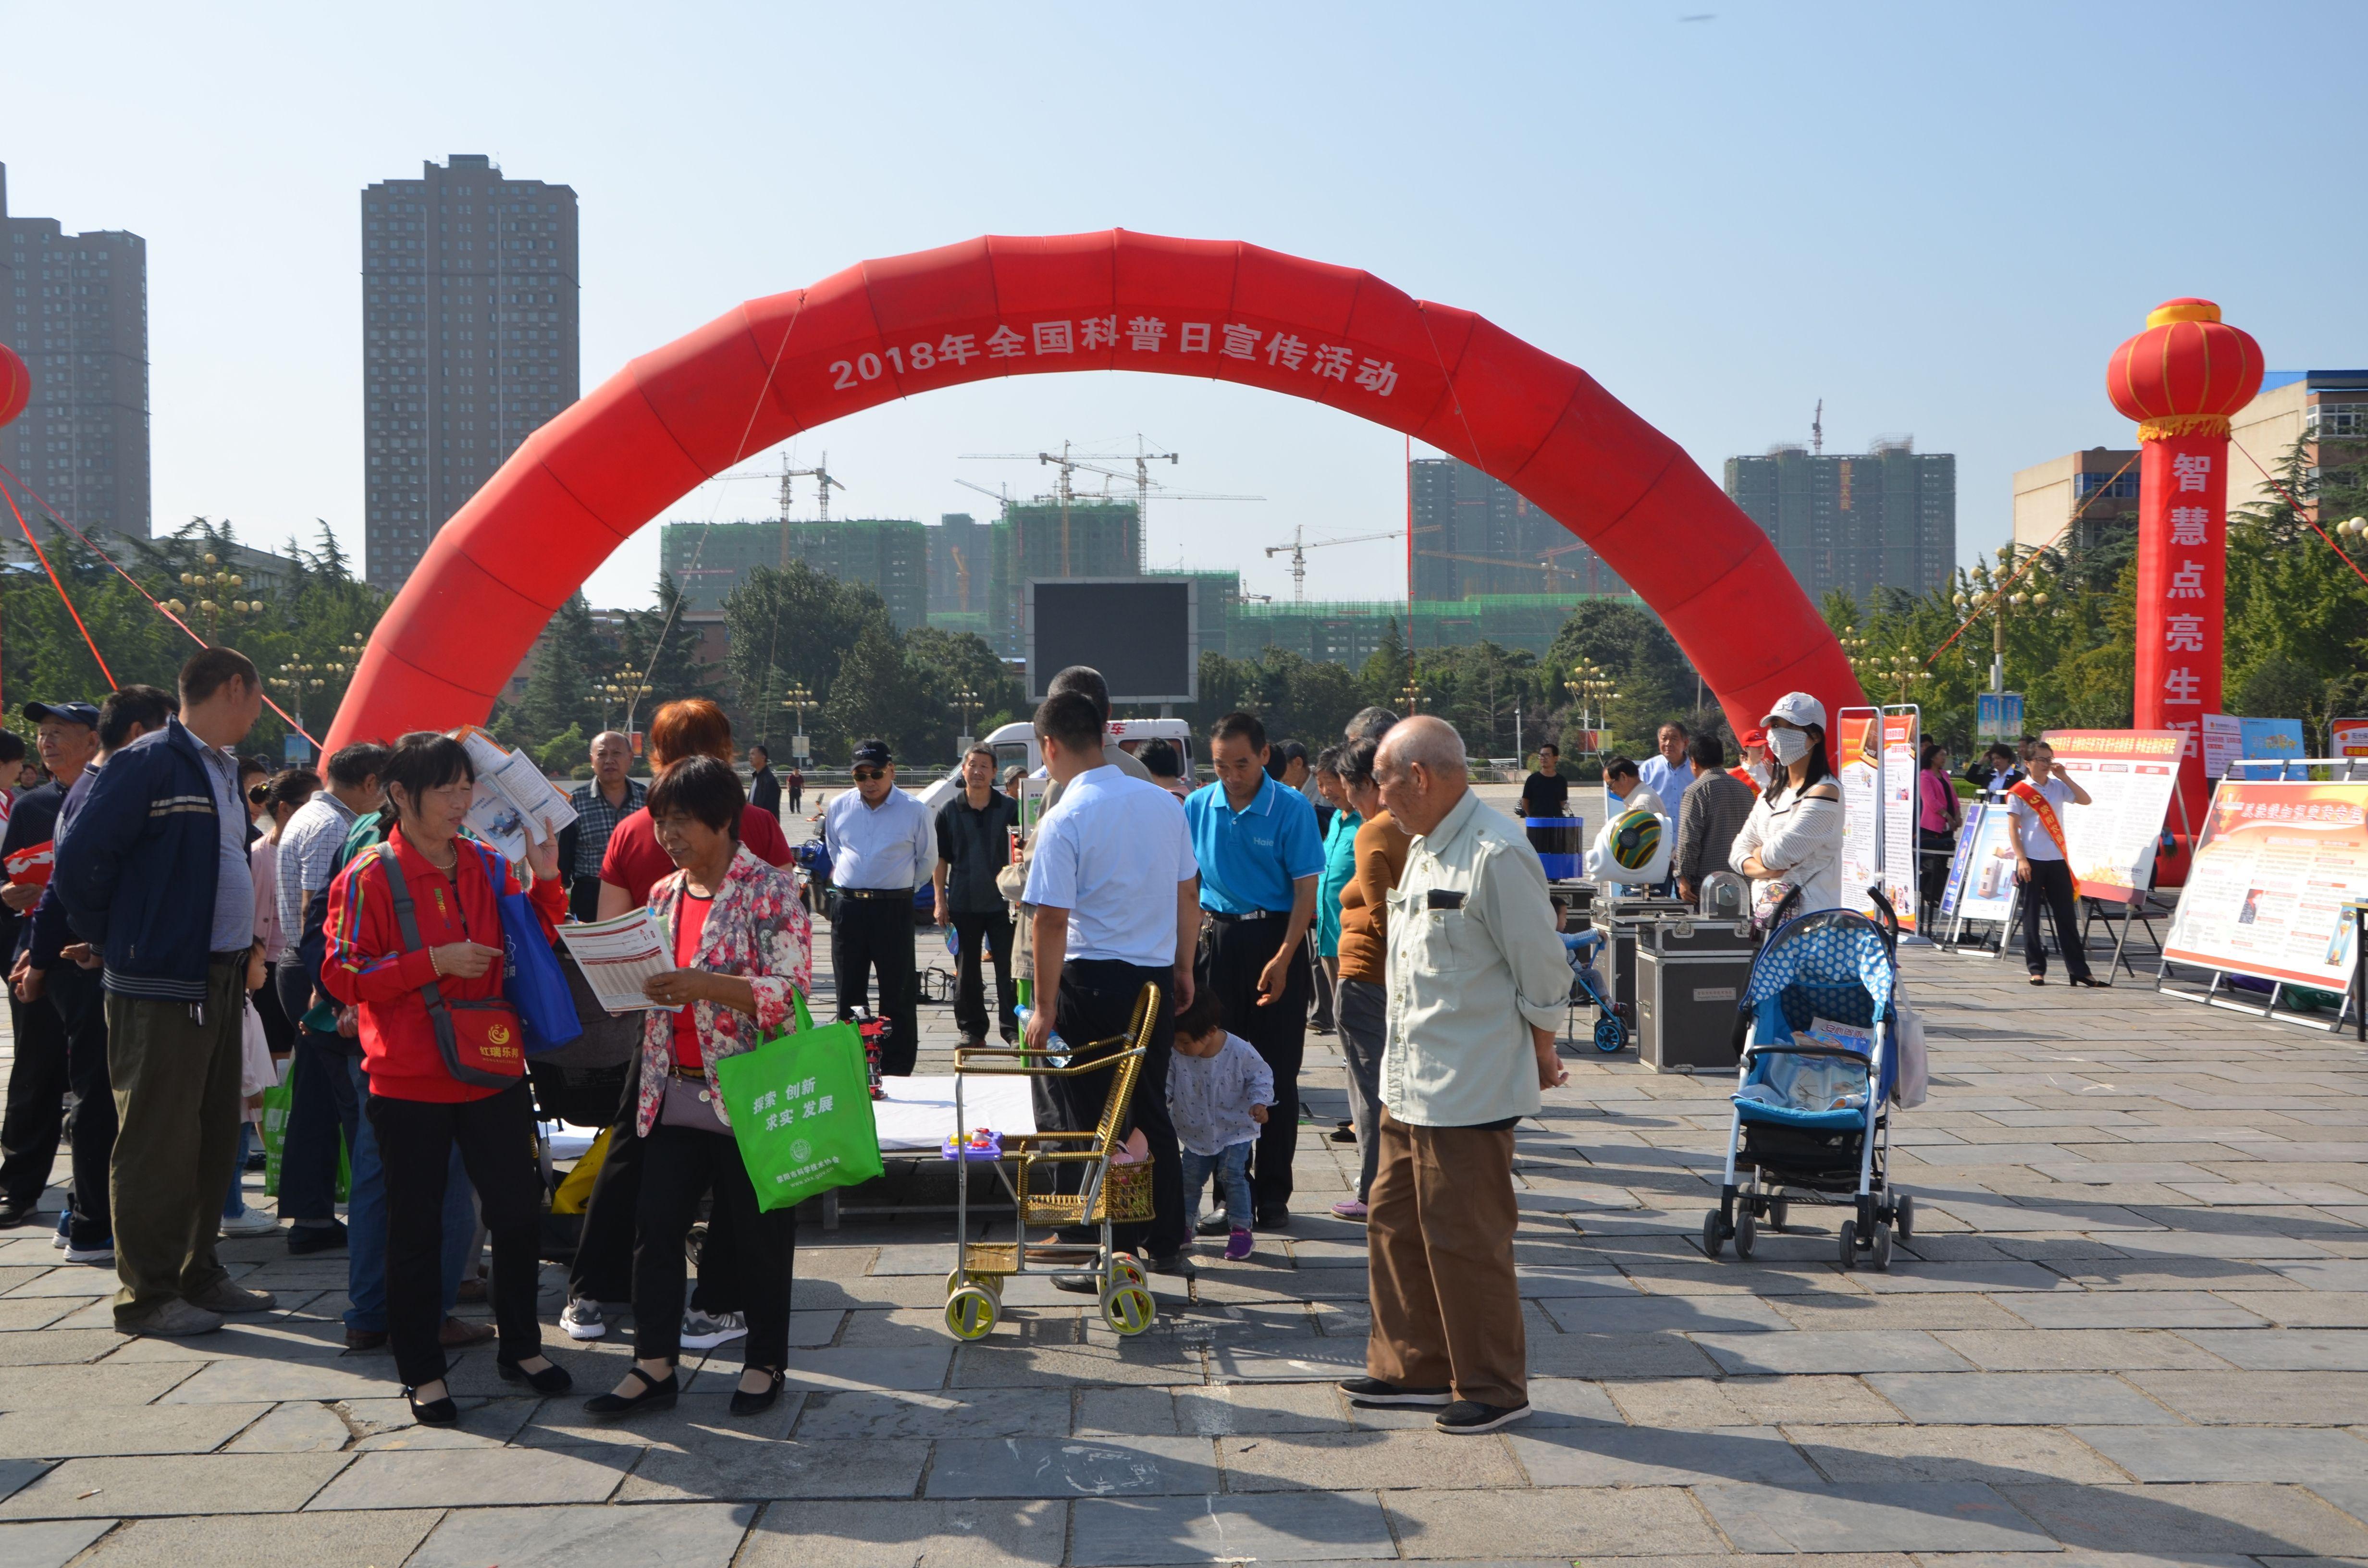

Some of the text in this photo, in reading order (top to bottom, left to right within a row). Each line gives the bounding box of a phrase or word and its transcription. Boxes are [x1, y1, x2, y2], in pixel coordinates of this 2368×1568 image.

[829, 314, 1399, 397] 2018年全国科普日宣传活动
[2164, 453, 2210, 759] 智慧点亮生活
[480, 1046, 518, 1059] 红瑞乐邦
[753, 1077, 816, 1115] 探索 创新
[766, 1095, 833, 1131] 求实 发展
[776, 1156, 839, 1184] 荥阳市科学技术协会
